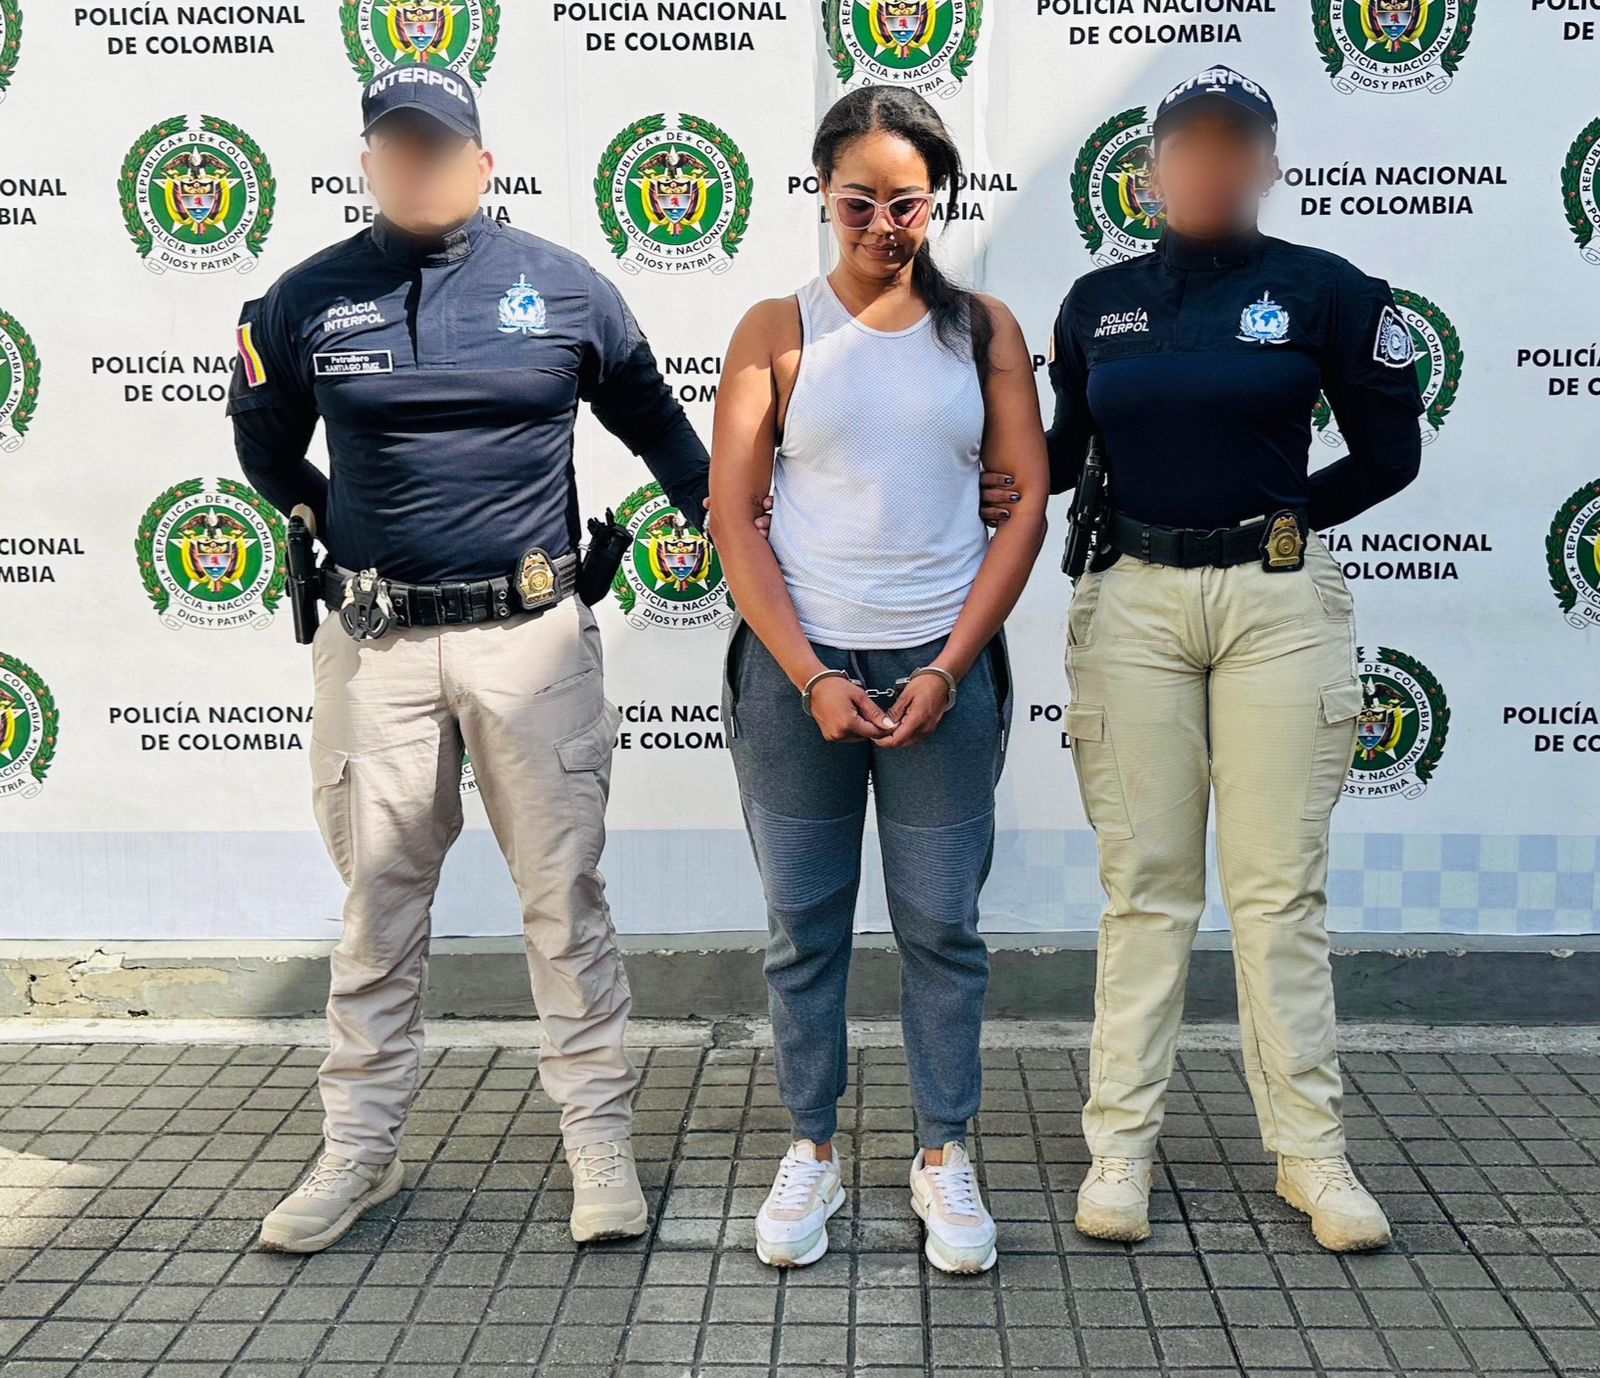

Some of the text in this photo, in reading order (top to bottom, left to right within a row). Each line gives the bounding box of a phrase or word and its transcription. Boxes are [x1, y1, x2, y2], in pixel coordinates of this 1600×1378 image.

[75, 1, 305, 26] POLICÍA NACIONAL
[657, 1, 787, 21] NACIONAL
[1143, 0, 1276, 14] NACIONAL
[1069, 23, 1242, 45] DE COLOMBIA
[1563, 21, 1595, 41] DE
[107, 35, 274, 55] DE COLOMBIA
[586, 32, 755, 51] DE COLOMBIA
[903, 40, 958, 80] NACIONAL
[1393, 34, 1450, 74] NACIONAL
[368, 67, 469, 104] INTERPOL
[1165, 68, 1268, 104] INTERPOL
[1392, 71, 1435, 90] PATRIA
[188, 133, 205, 142] DE
[218, 140, 257, 204] COLOMBIA
[666, 132, 683, 141] DE
[695, 139, 733, 204] COLOMBIA
[1283, 161, 1508, 187] OLICÍA NACIONAL
[344, 205, 373, 224] DE
[1301, 195, 1474, 216] DE COLOMBIA
[200, 217, 252, 255] NACIONAL
[676, 217, 729, 255] NACIONAL
[201, 252, 242, 270] PATRIA
[676, 252, 716, 271] PATRIA
[323, 313, 386, 333] INTERPOL
[1100, 307, 1148, 327] POLICÍA
[1093, 321, 1150, 338] INTERPOL
[1406, 313, 1442, 377] COLOMBIA
[1517, 343, 1600, 367] POLICÍ
[92, 350, 185, 374] POLICÍA
[324, 363, 361, 372] SANTIAGO
[124, 384, 153, 402] DE
[1548, 377, 1579, 396] DE
[205, 495, 222, 504] DE
[234, 502, 273, 562] COLOMBIA
[0, 538, 85, 555] CIONAL
[1361, 533, 1492, 552] NACIONAL
[1339, 561, 1459, 580] OLOMBIA
[217, 576, 270, 612] NACIONAL
[682, 581, 728, 611] NACIONA
[217, 609, 257, 627] PATRIA
[682, 608, 722, 626] PATRIA
[3, 673, 41, 733] COLOMBIA
[1364, 664, 1430, 732] DE COLOMBIA
[109, 701, 201, 724] POLICÍA
[1503, 701, 1599, 725] POLICÍA
[141, 733, 303, 751] DE COLOMBIA
[1534, 734, 1565, 752] DE
[1368, 744, 1424, 781] NACIONAL
[1368, 778, 1410, 796] PATRIA
